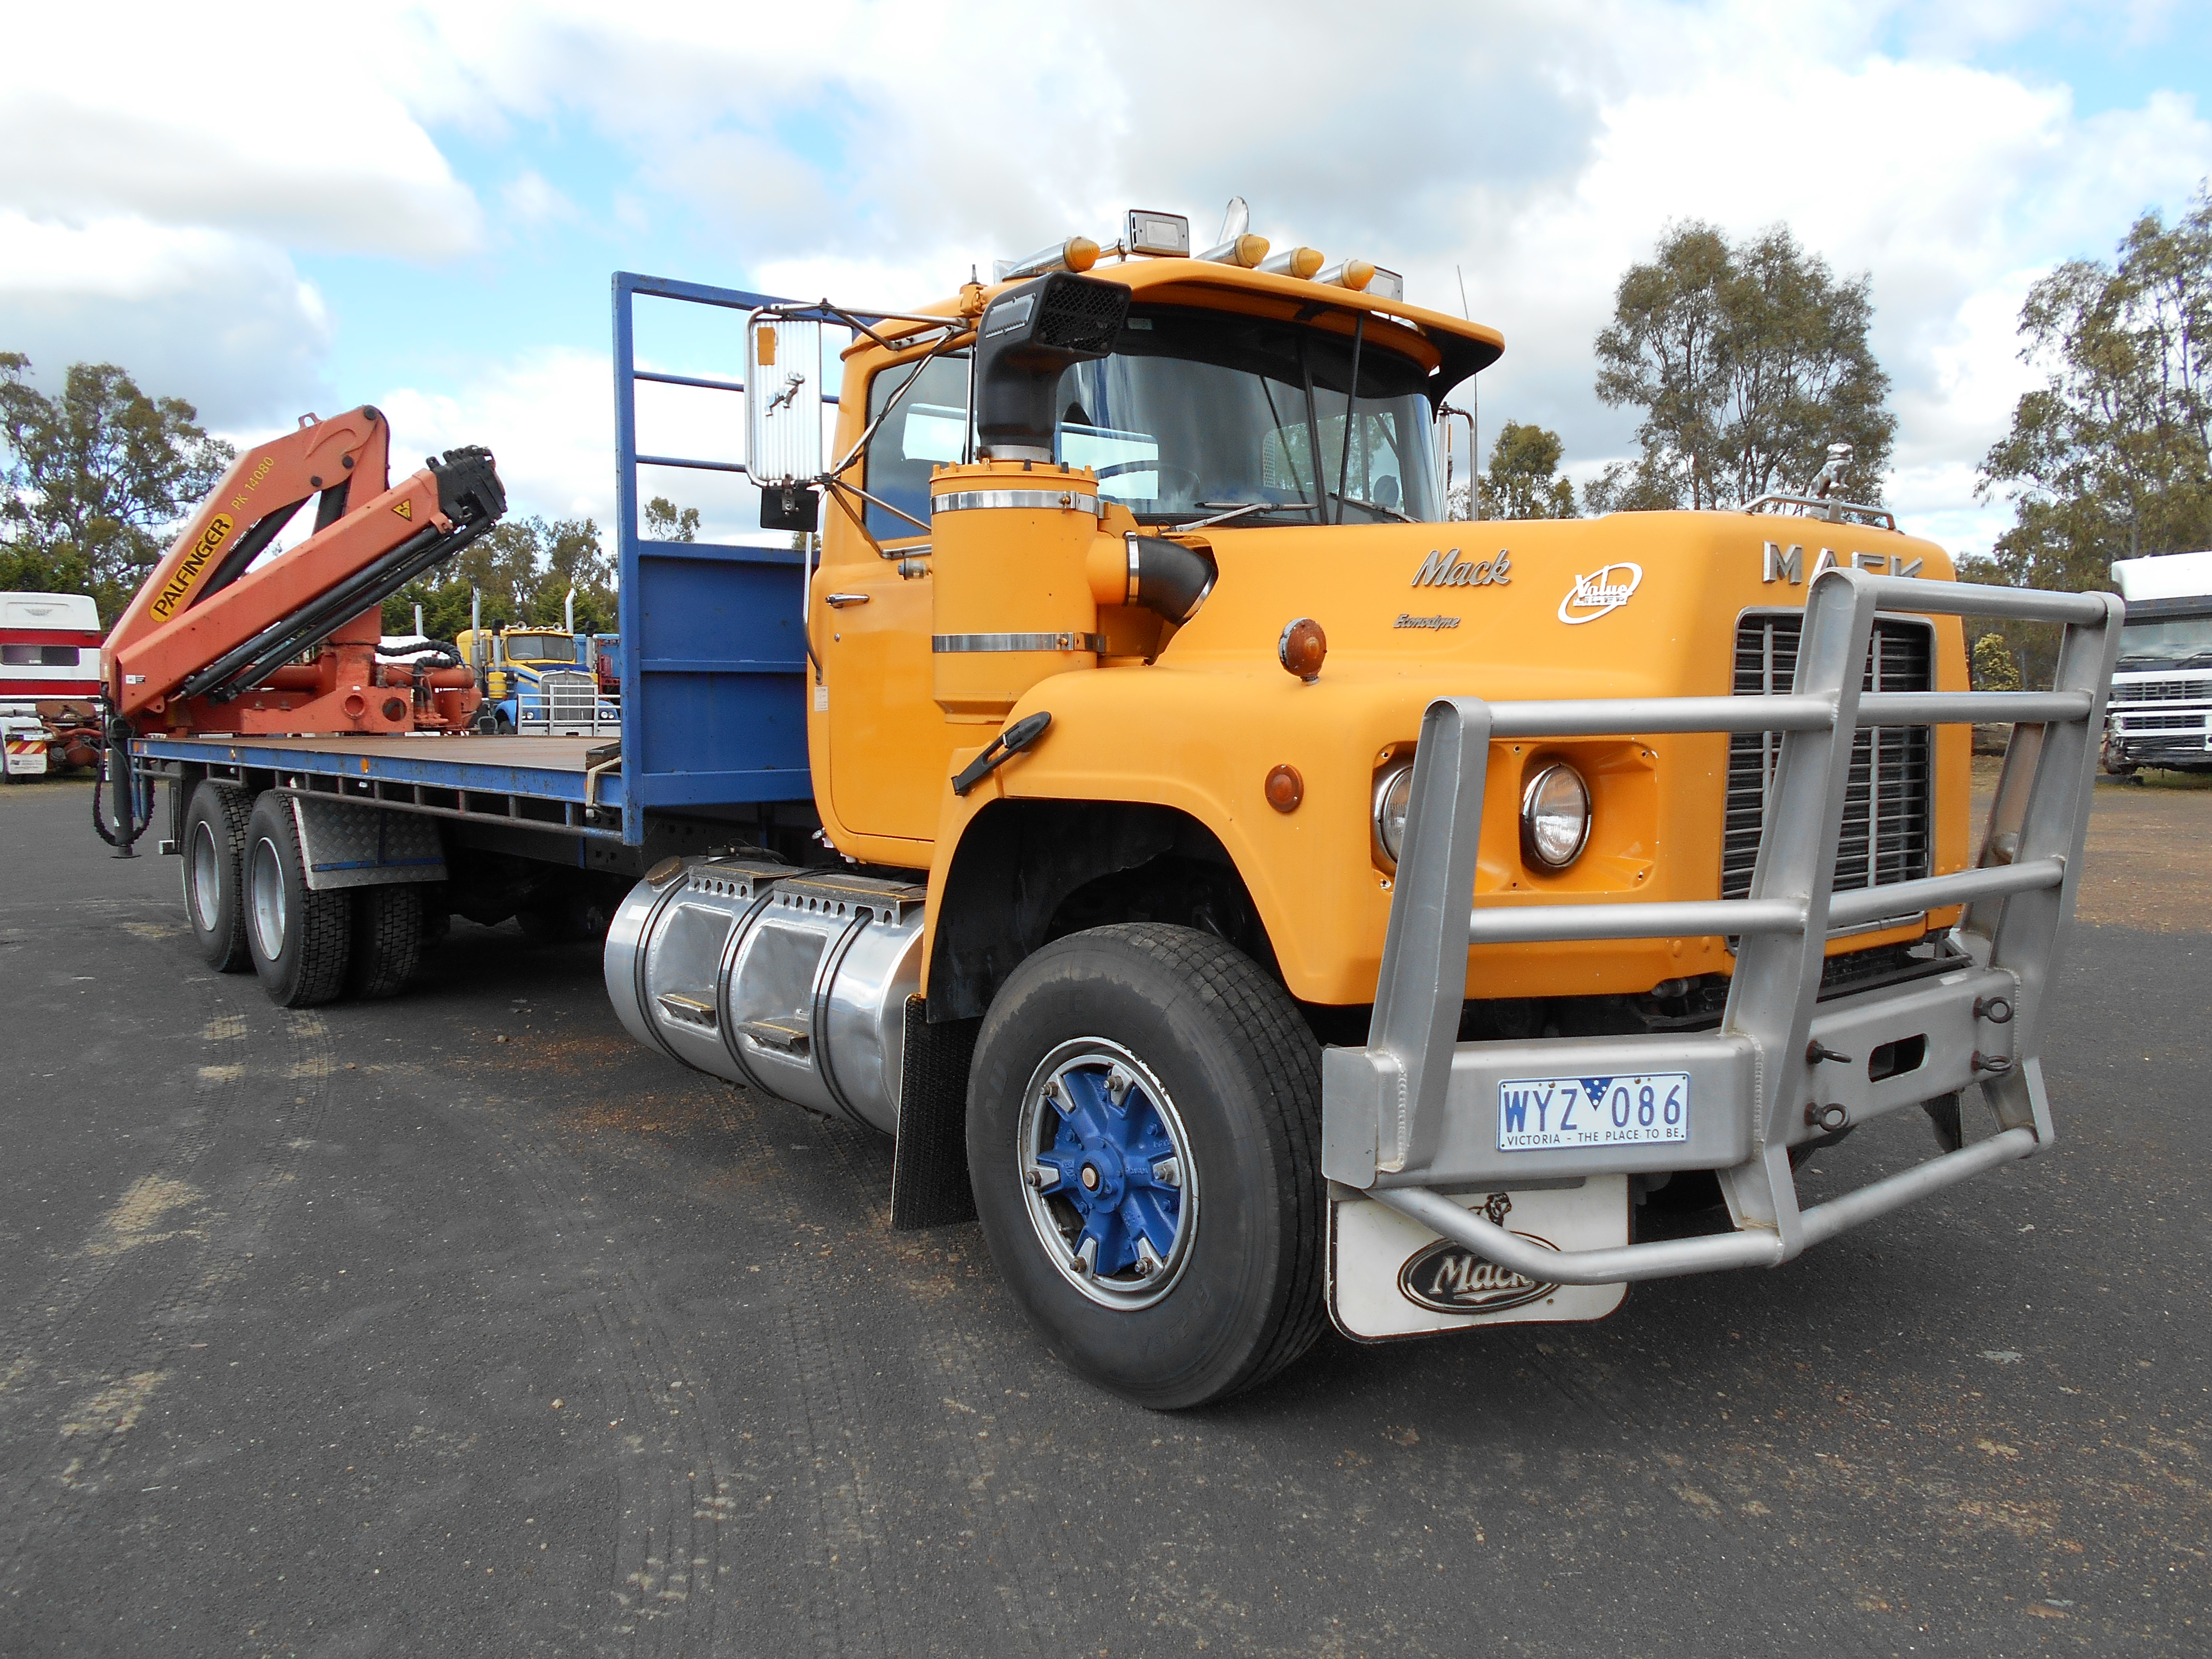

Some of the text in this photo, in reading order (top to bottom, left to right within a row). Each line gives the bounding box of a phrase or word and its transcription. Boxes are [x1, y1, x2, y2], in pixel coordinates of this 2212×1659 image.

[231, 456, 274, 510] PK 14080
[153, 518, 230, 617] PALFINGER
[1410, 548, 1510, 586] Mack
[1574, 565, 1633, 598] Value
[1504, 1084, 1681, 1133] WYZ 086
[1507, 1134, 1560, 1146] VICTORIA
[1578, 1131, 1598, 1142] THE
[1606, 1130, 1639, 1141] PLACE
[1646, 1128, 1659, 1139] TO
[1666, 1127, 1679, 1138] BE
